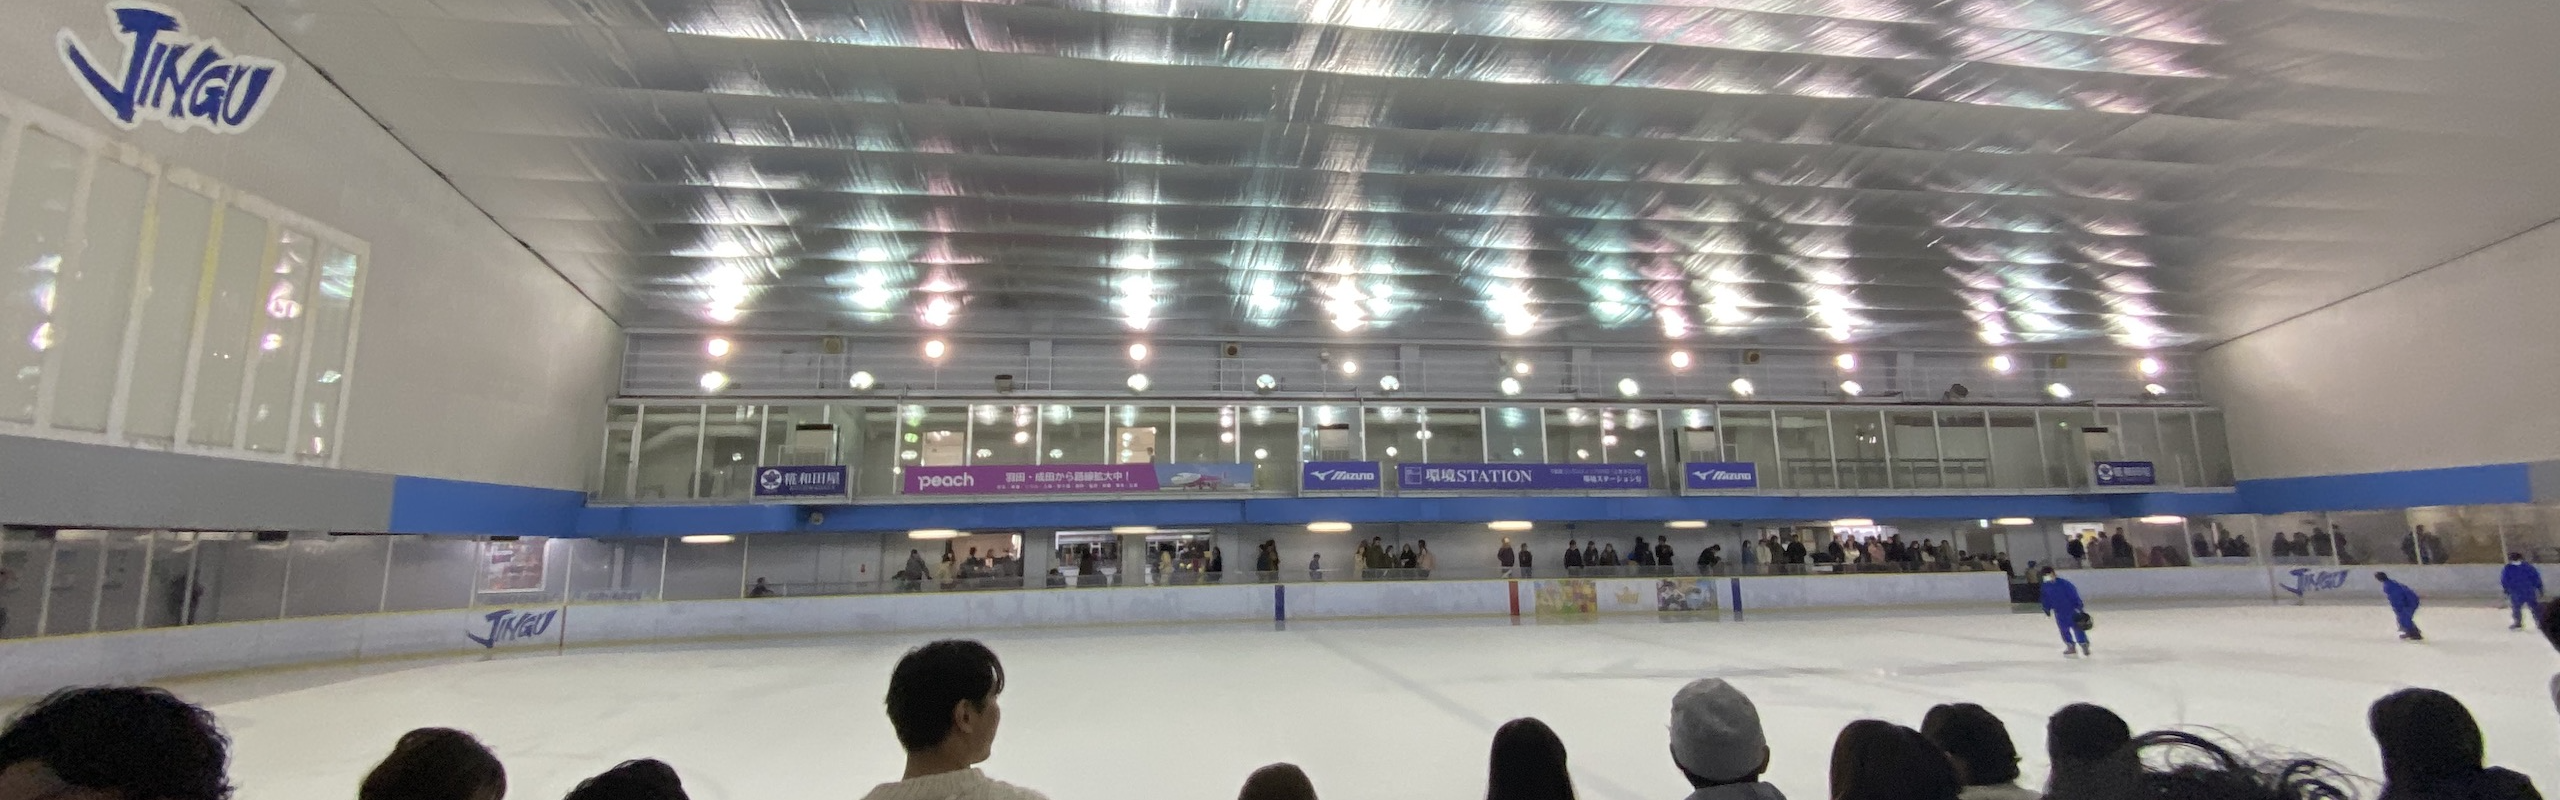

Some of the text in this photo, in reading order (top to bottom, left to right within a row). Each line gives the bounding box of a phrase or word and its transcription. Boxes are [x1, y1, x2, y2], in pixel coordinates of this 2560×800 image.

[65, 7, 275, 126] JINGU
[917, 472, 975, 491] peach
[1425, 468, 1533, 483] 環境STATION
[2279, 568, 2349, 597] JINGU
[467, 609, 558, 649] JINGU
